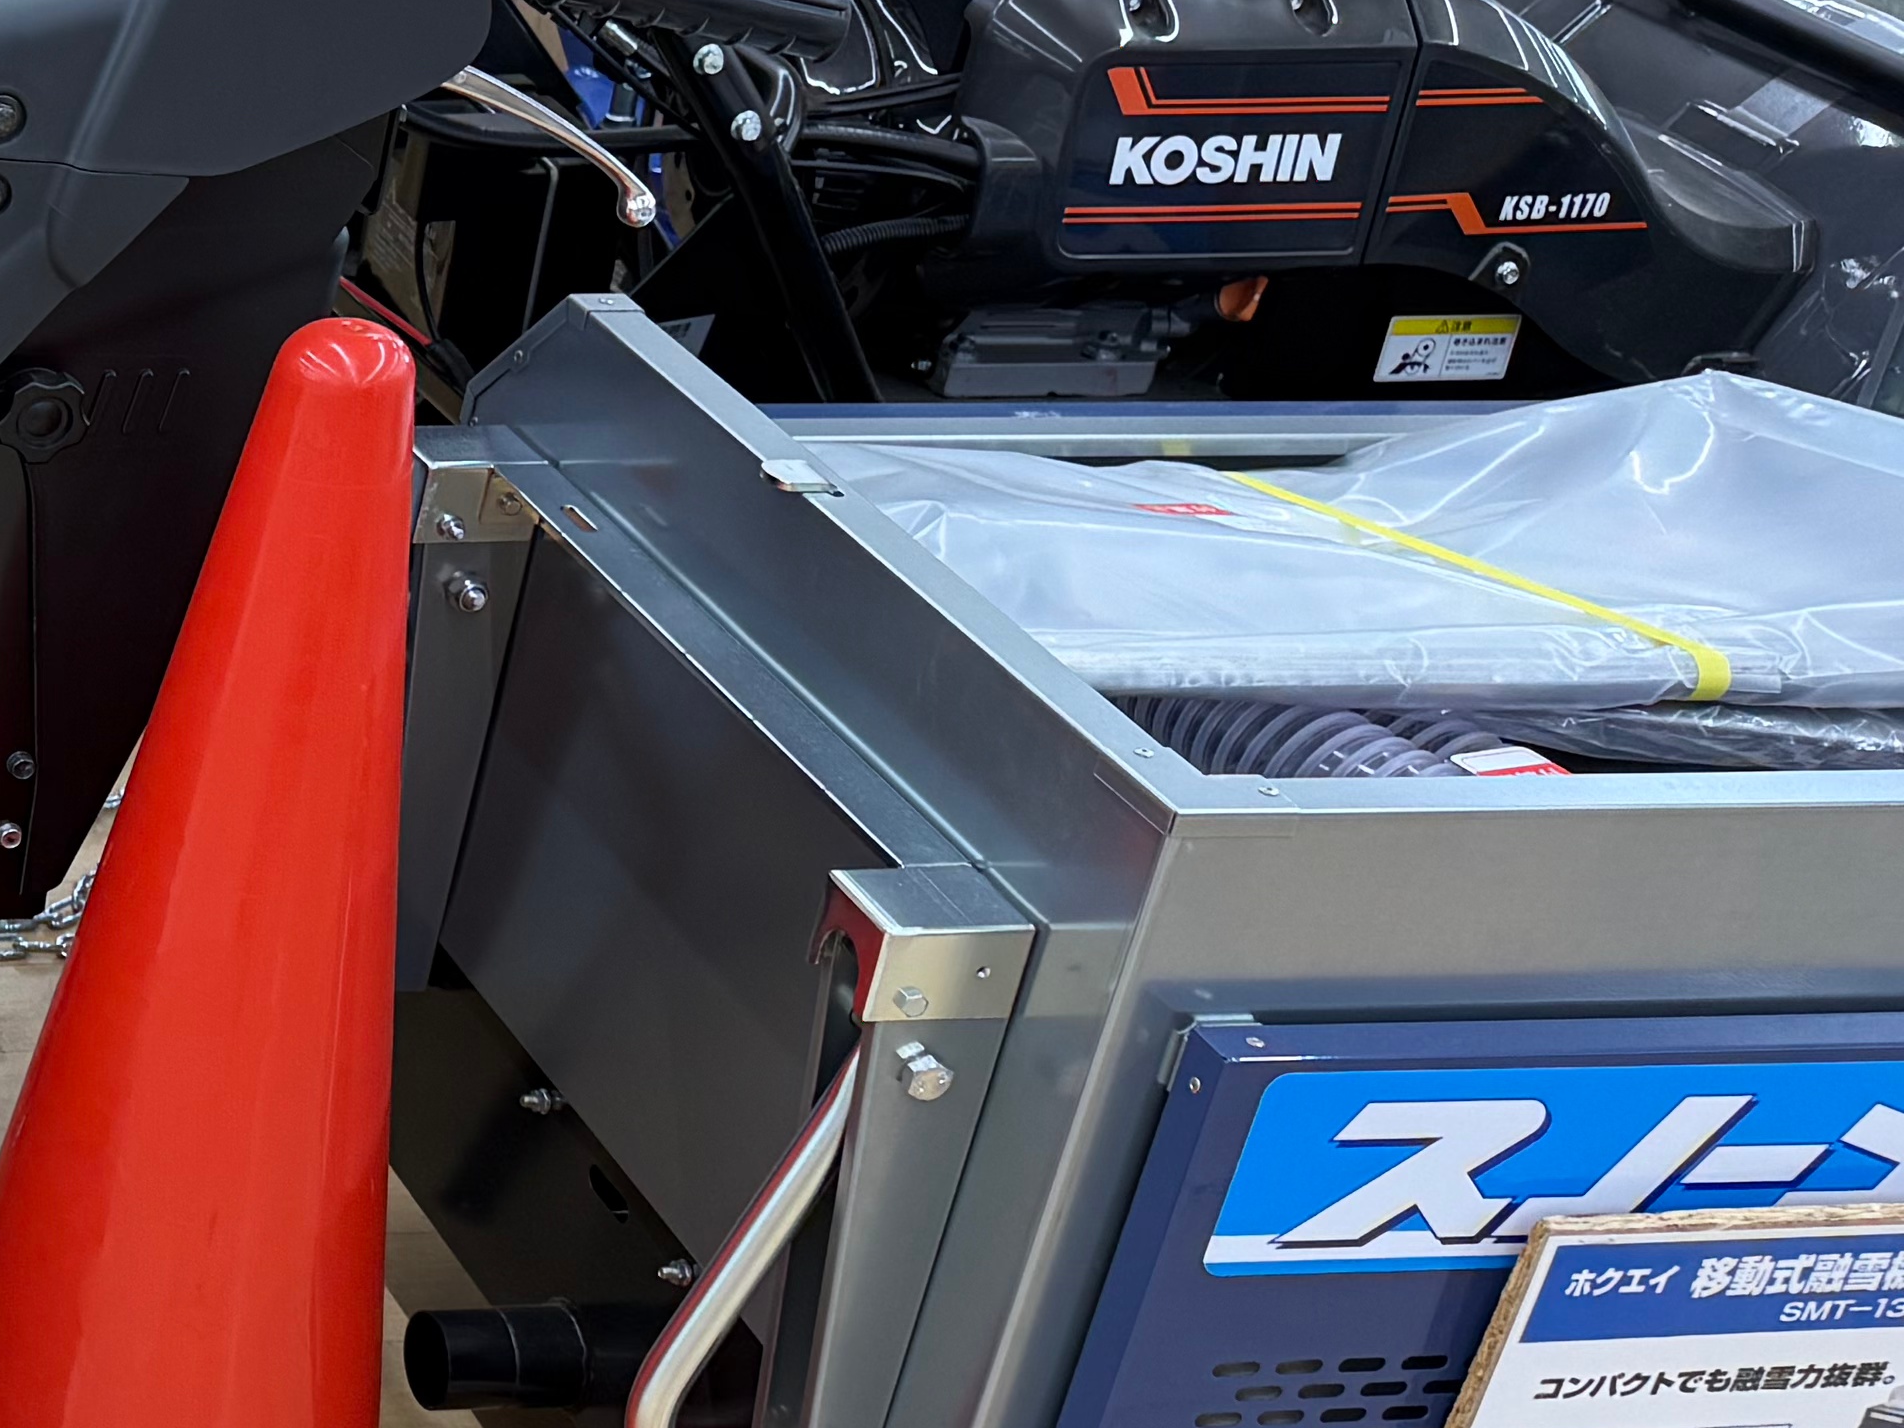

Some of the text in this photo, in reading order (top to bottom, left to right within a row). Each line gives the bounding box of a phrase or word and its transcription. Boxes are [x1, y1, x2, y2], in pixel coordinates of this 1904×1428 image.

[1109, 133, 1342, 186] KOSHIN
[1499, 193, 1610, 220] KSB-1170
[1565, 1265, 1680, 1298] ホクエイ
[1533, 1360, 1895, 1400] コンパクトでも融雪力抜群。
